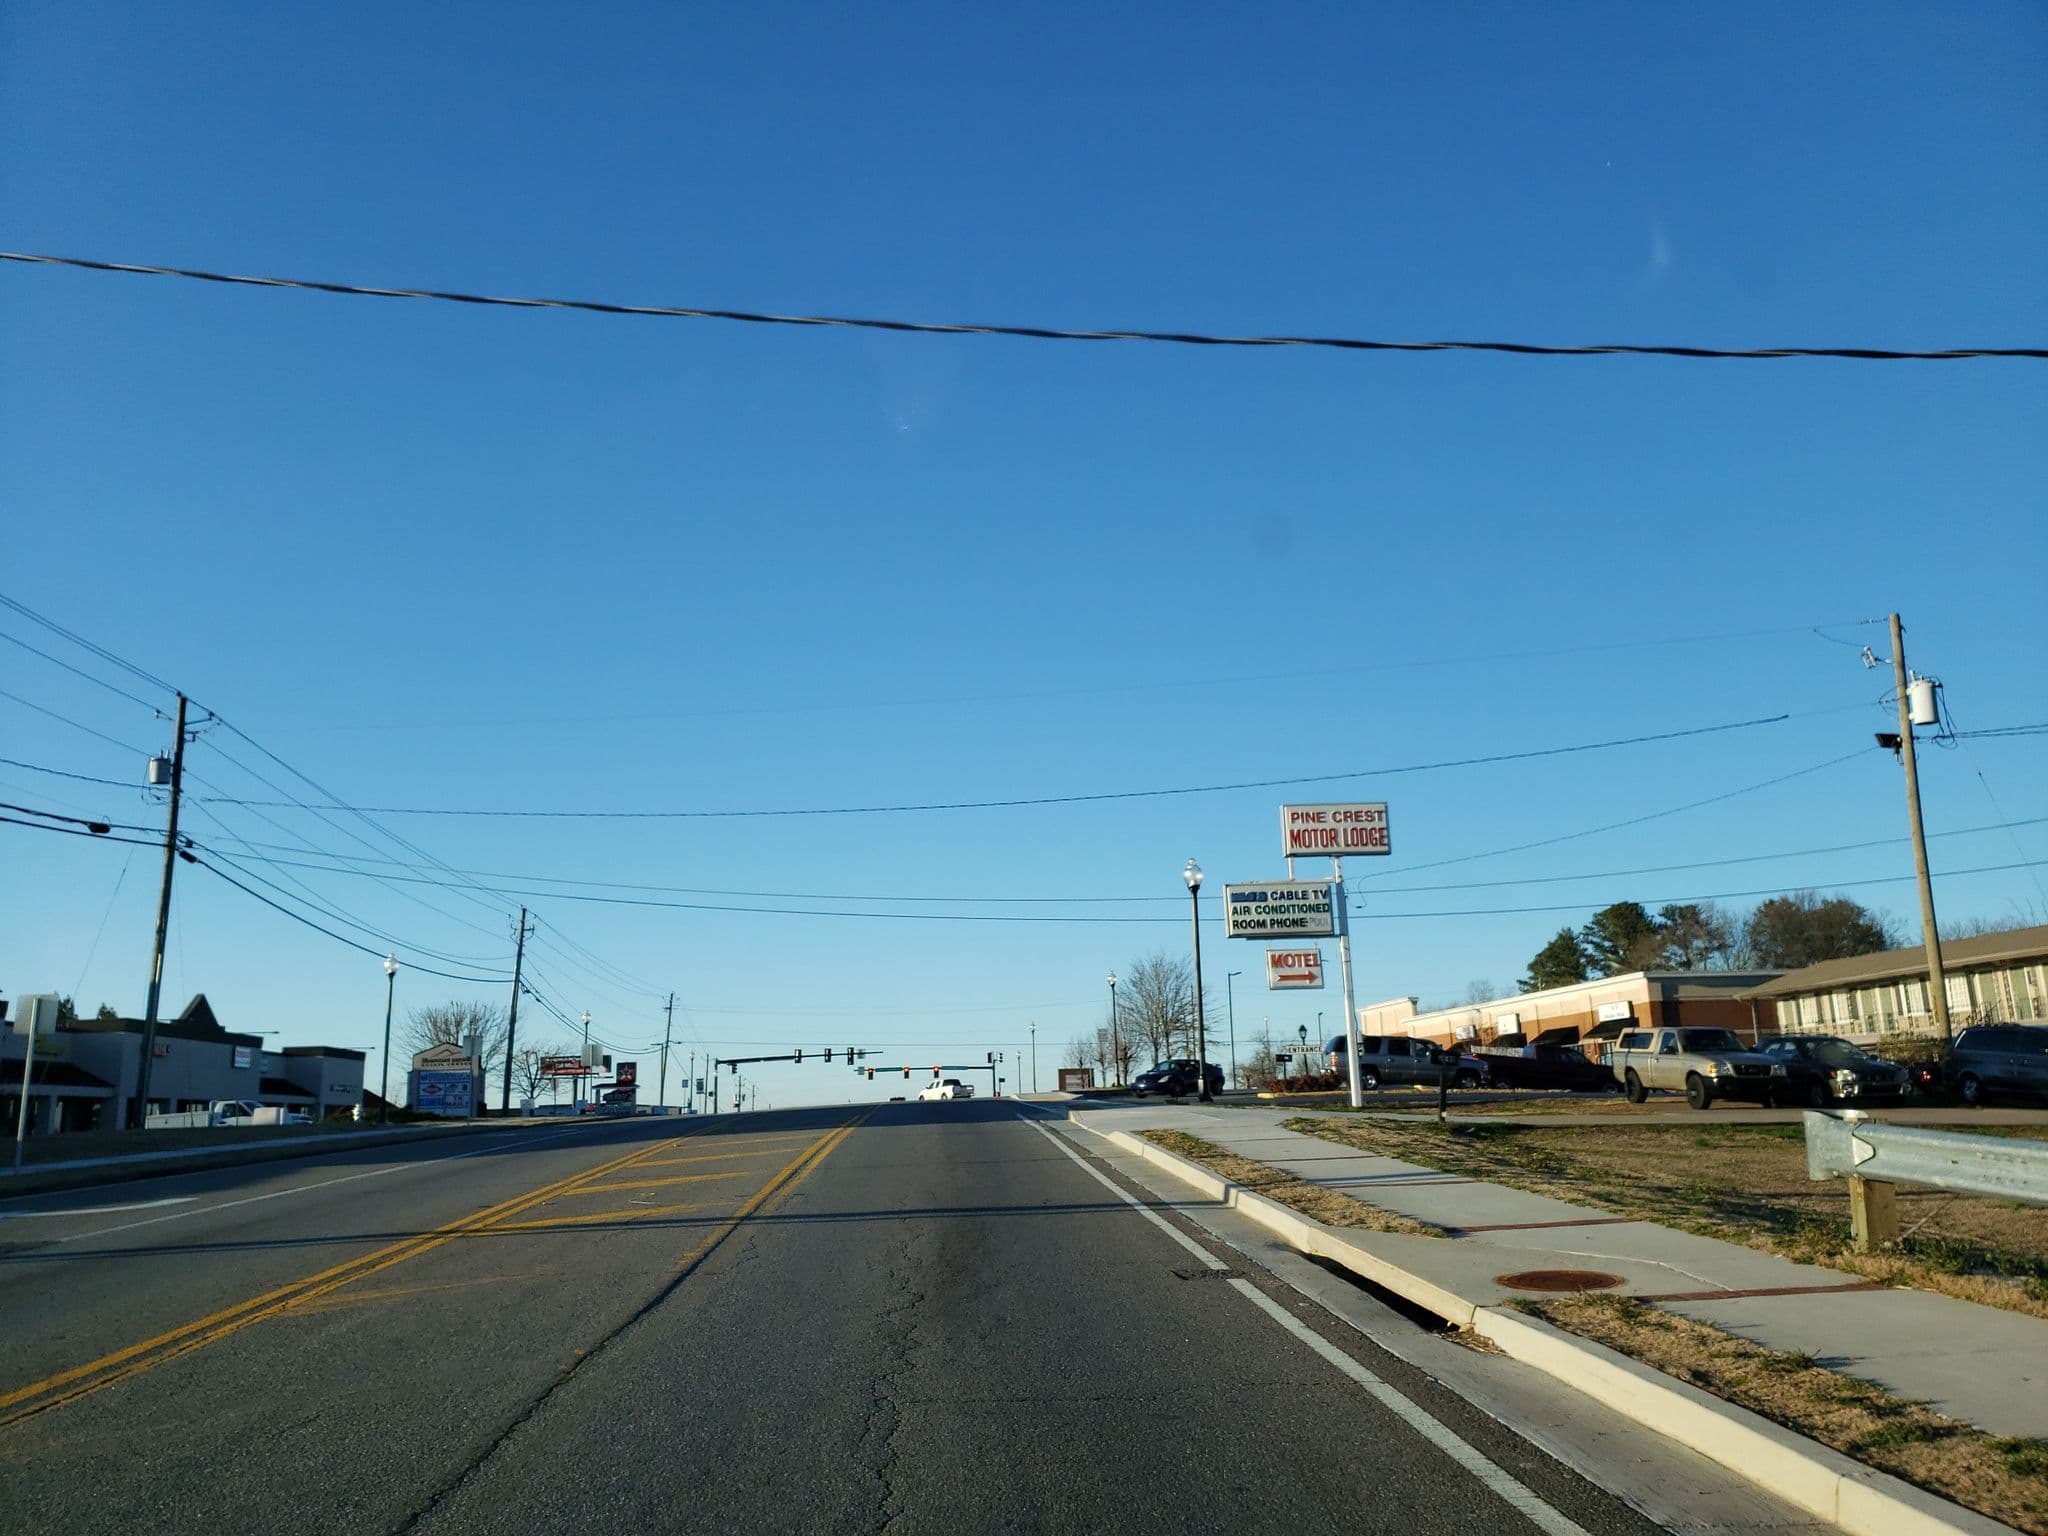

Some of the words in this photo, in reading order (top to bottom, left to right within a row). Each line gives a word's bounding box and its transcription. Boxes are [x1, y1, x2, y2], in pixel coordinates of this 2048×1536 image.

[1290, 811, 1327, 824] PINE
[1331, 810, 1385, 823] CREST
[1290, 828, 1338, 849] MOTOR
[1344, 827, 1387, 847] LODGE
[1270, 890, 1309, 901] CABLE
[1311, 889, 1328, 900] TV
[1231, 906, 1251, 916] AIR
[1254, 903, 1329, 915] CONDITIONED
[1232, 919, 1267, 930] ROOM
[1270, 953, 1320, 969] MOTEL
